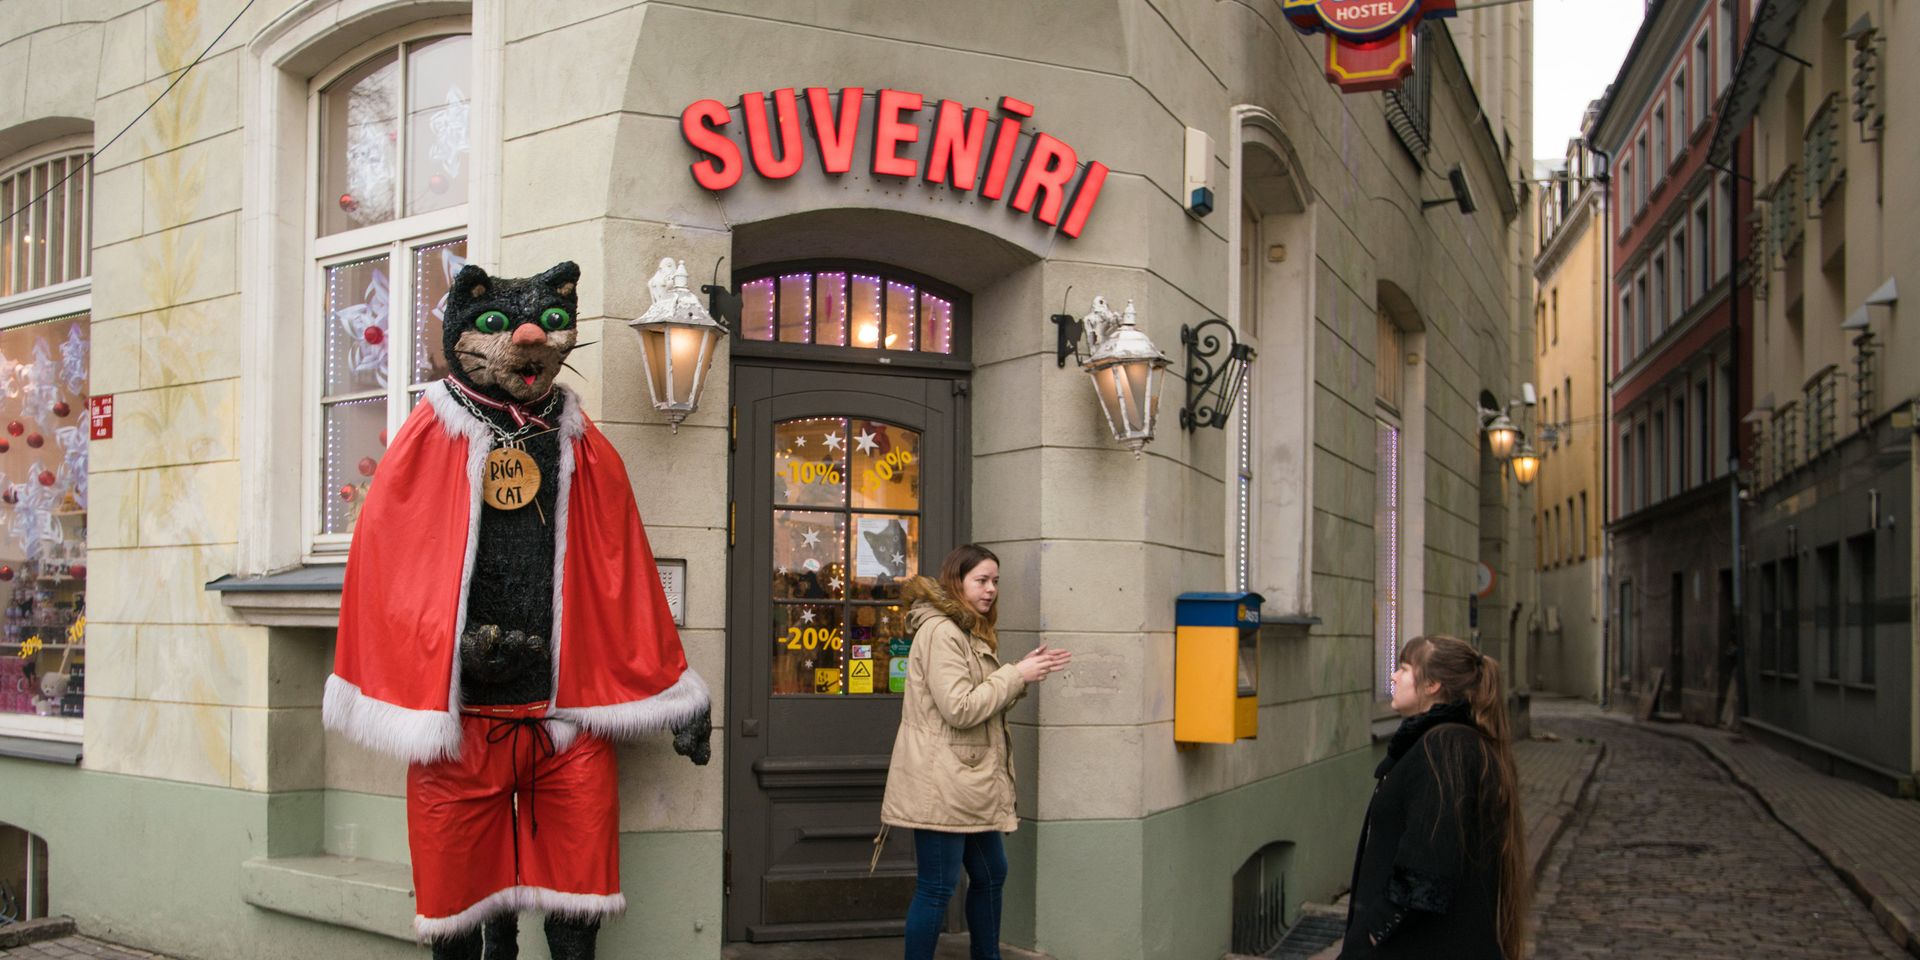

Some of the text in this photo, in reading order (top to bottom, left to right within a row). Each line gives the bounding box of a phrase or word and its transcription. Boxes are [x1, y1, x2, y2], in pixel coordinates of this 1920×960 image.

[1336, 3, 1397, 21] HOSTEL
[680, 87, 1110, 239] SUVENĪRI
[777, 461, 840, 485] -10%
[496, 486, 522, 505] CAT
[18, 634, 43, 659] -30%
[778, 627, 842, 650] -20%
